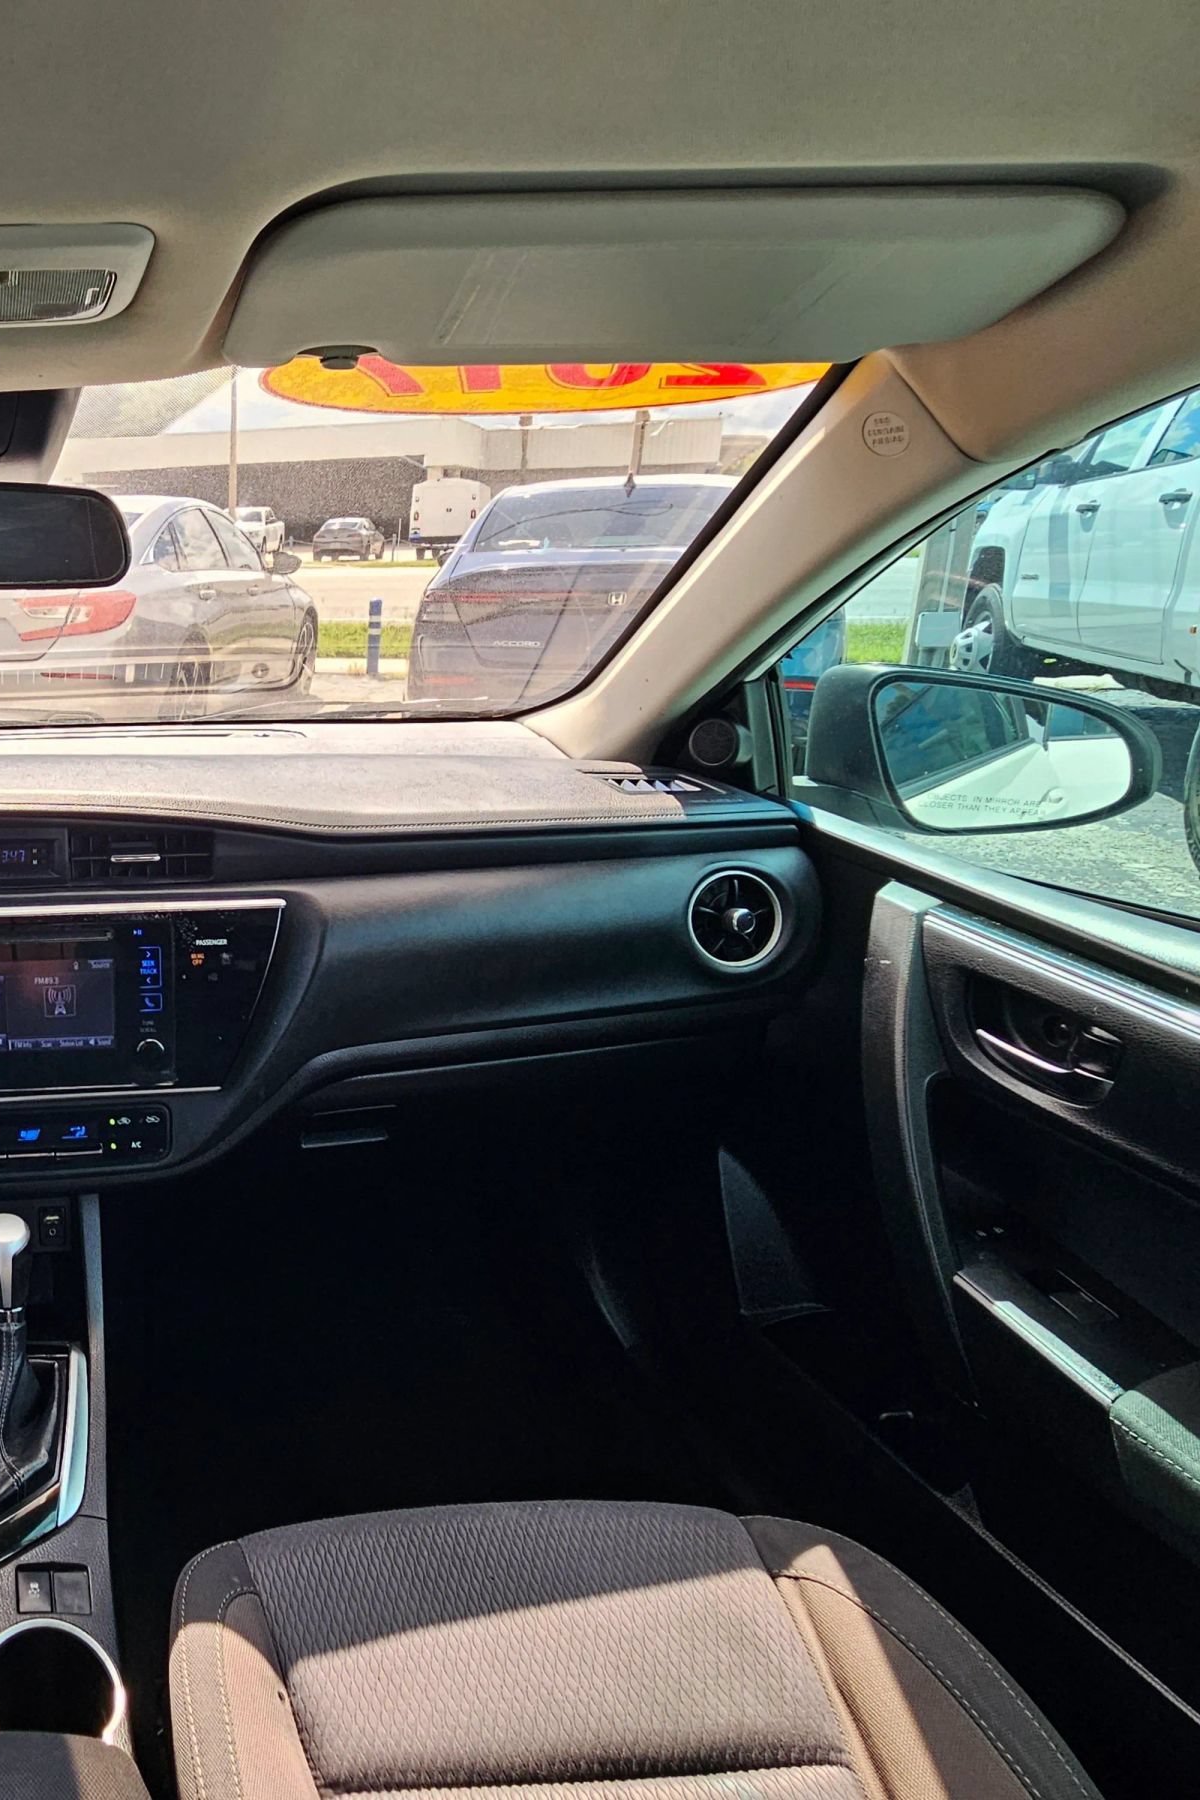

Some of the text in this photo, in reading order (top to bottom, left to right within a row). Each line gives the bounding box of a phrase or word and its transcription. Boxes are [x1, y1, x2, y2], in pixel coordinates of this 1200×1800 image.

[957, 803, 980, 811] THAN
[984, 805, 1007, 813] THEY
[195, 938, 228, 946] PASSENGER
